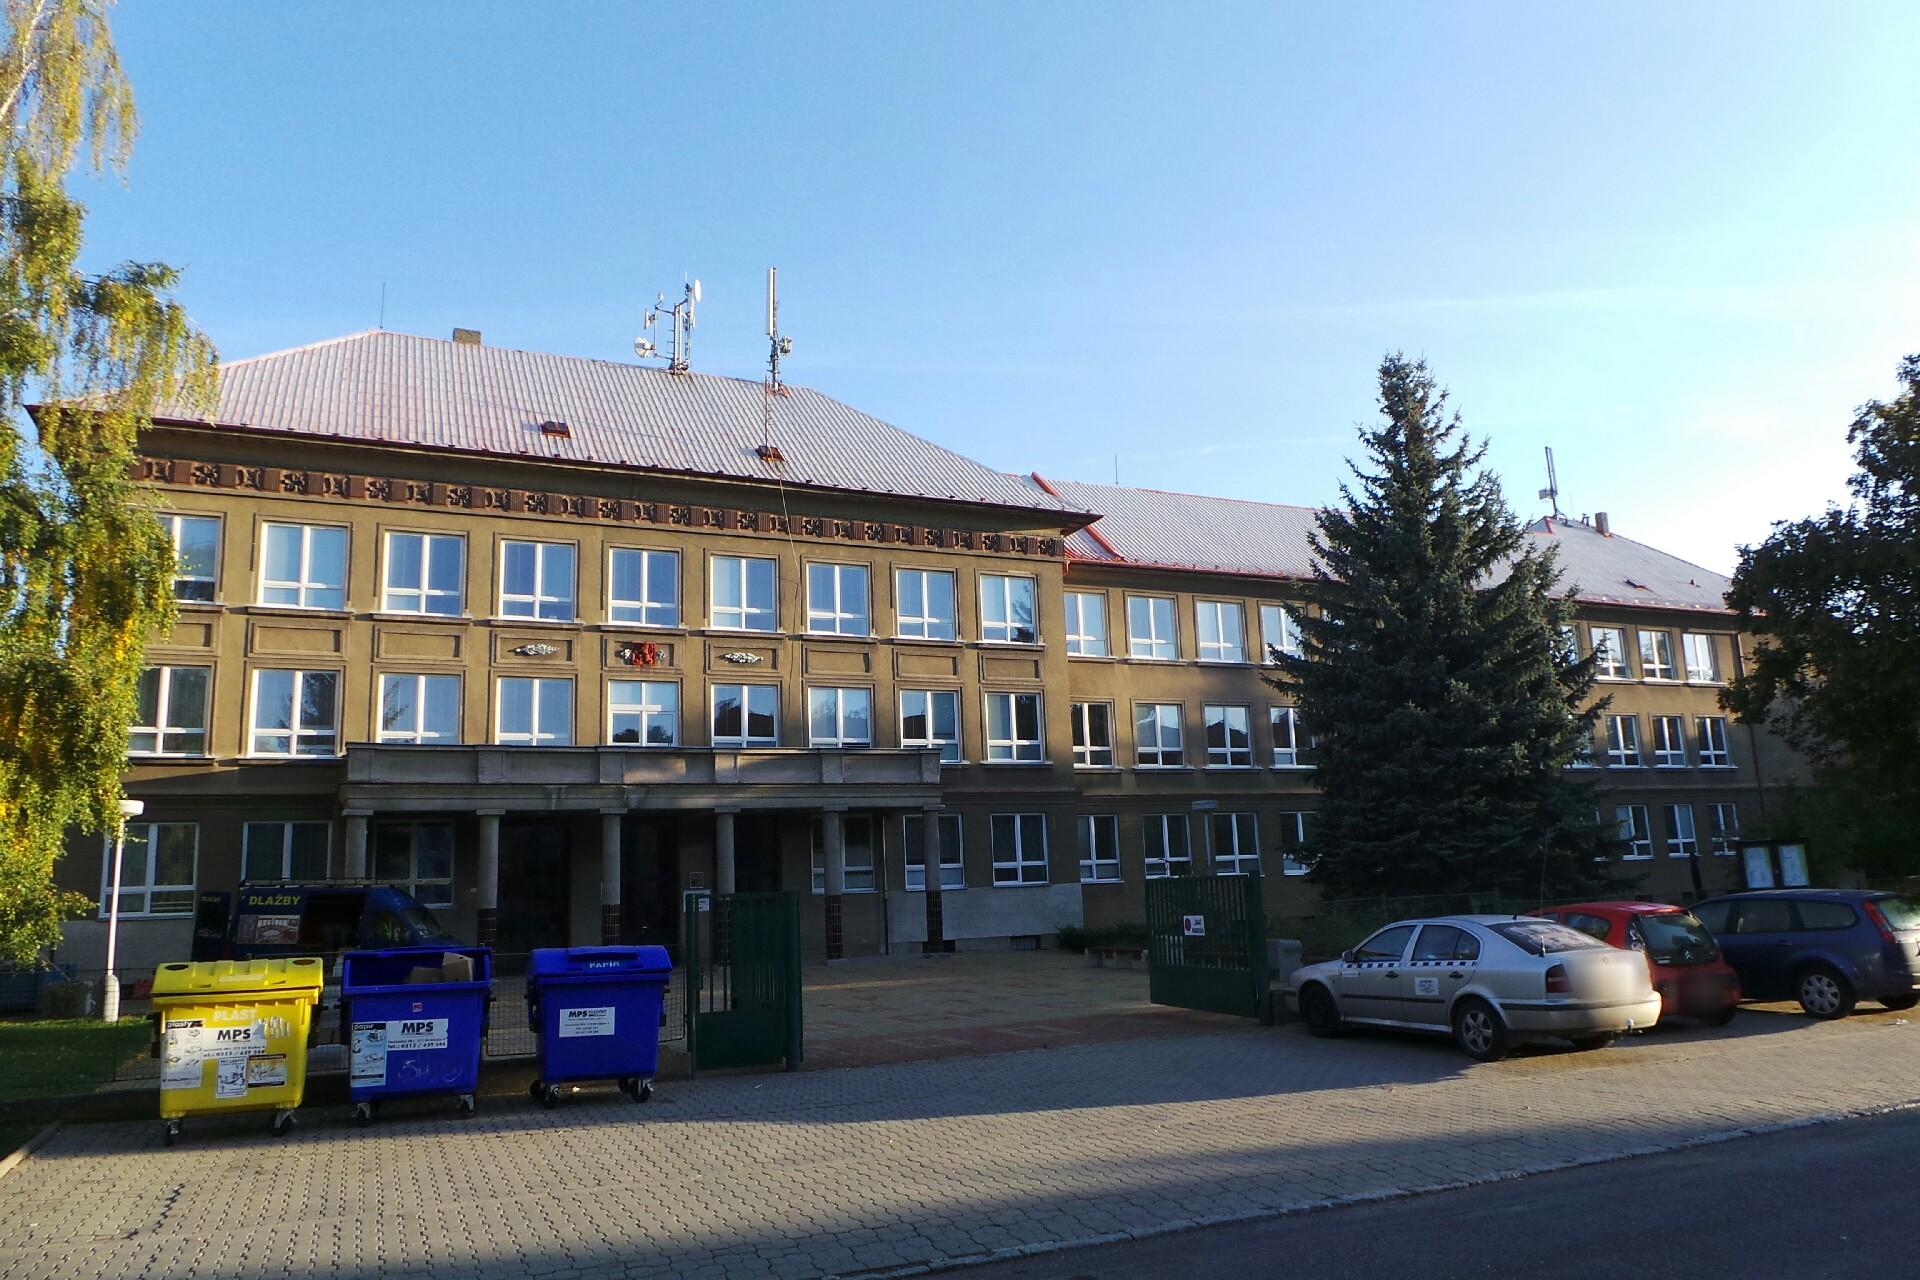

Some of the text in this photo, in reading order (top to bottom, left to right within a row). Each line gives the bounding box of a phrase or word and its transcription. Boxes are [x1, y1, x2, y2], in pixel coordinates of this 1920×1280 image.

[248, 894, 301, 905] DLAŽBY
[213, 1009, 257, 1021] PLAST
[568, 1010, 588, 1018] MPS
[402, 1022, 434, 1034] MPS
[217, 1028, 251, 1041] MPS
